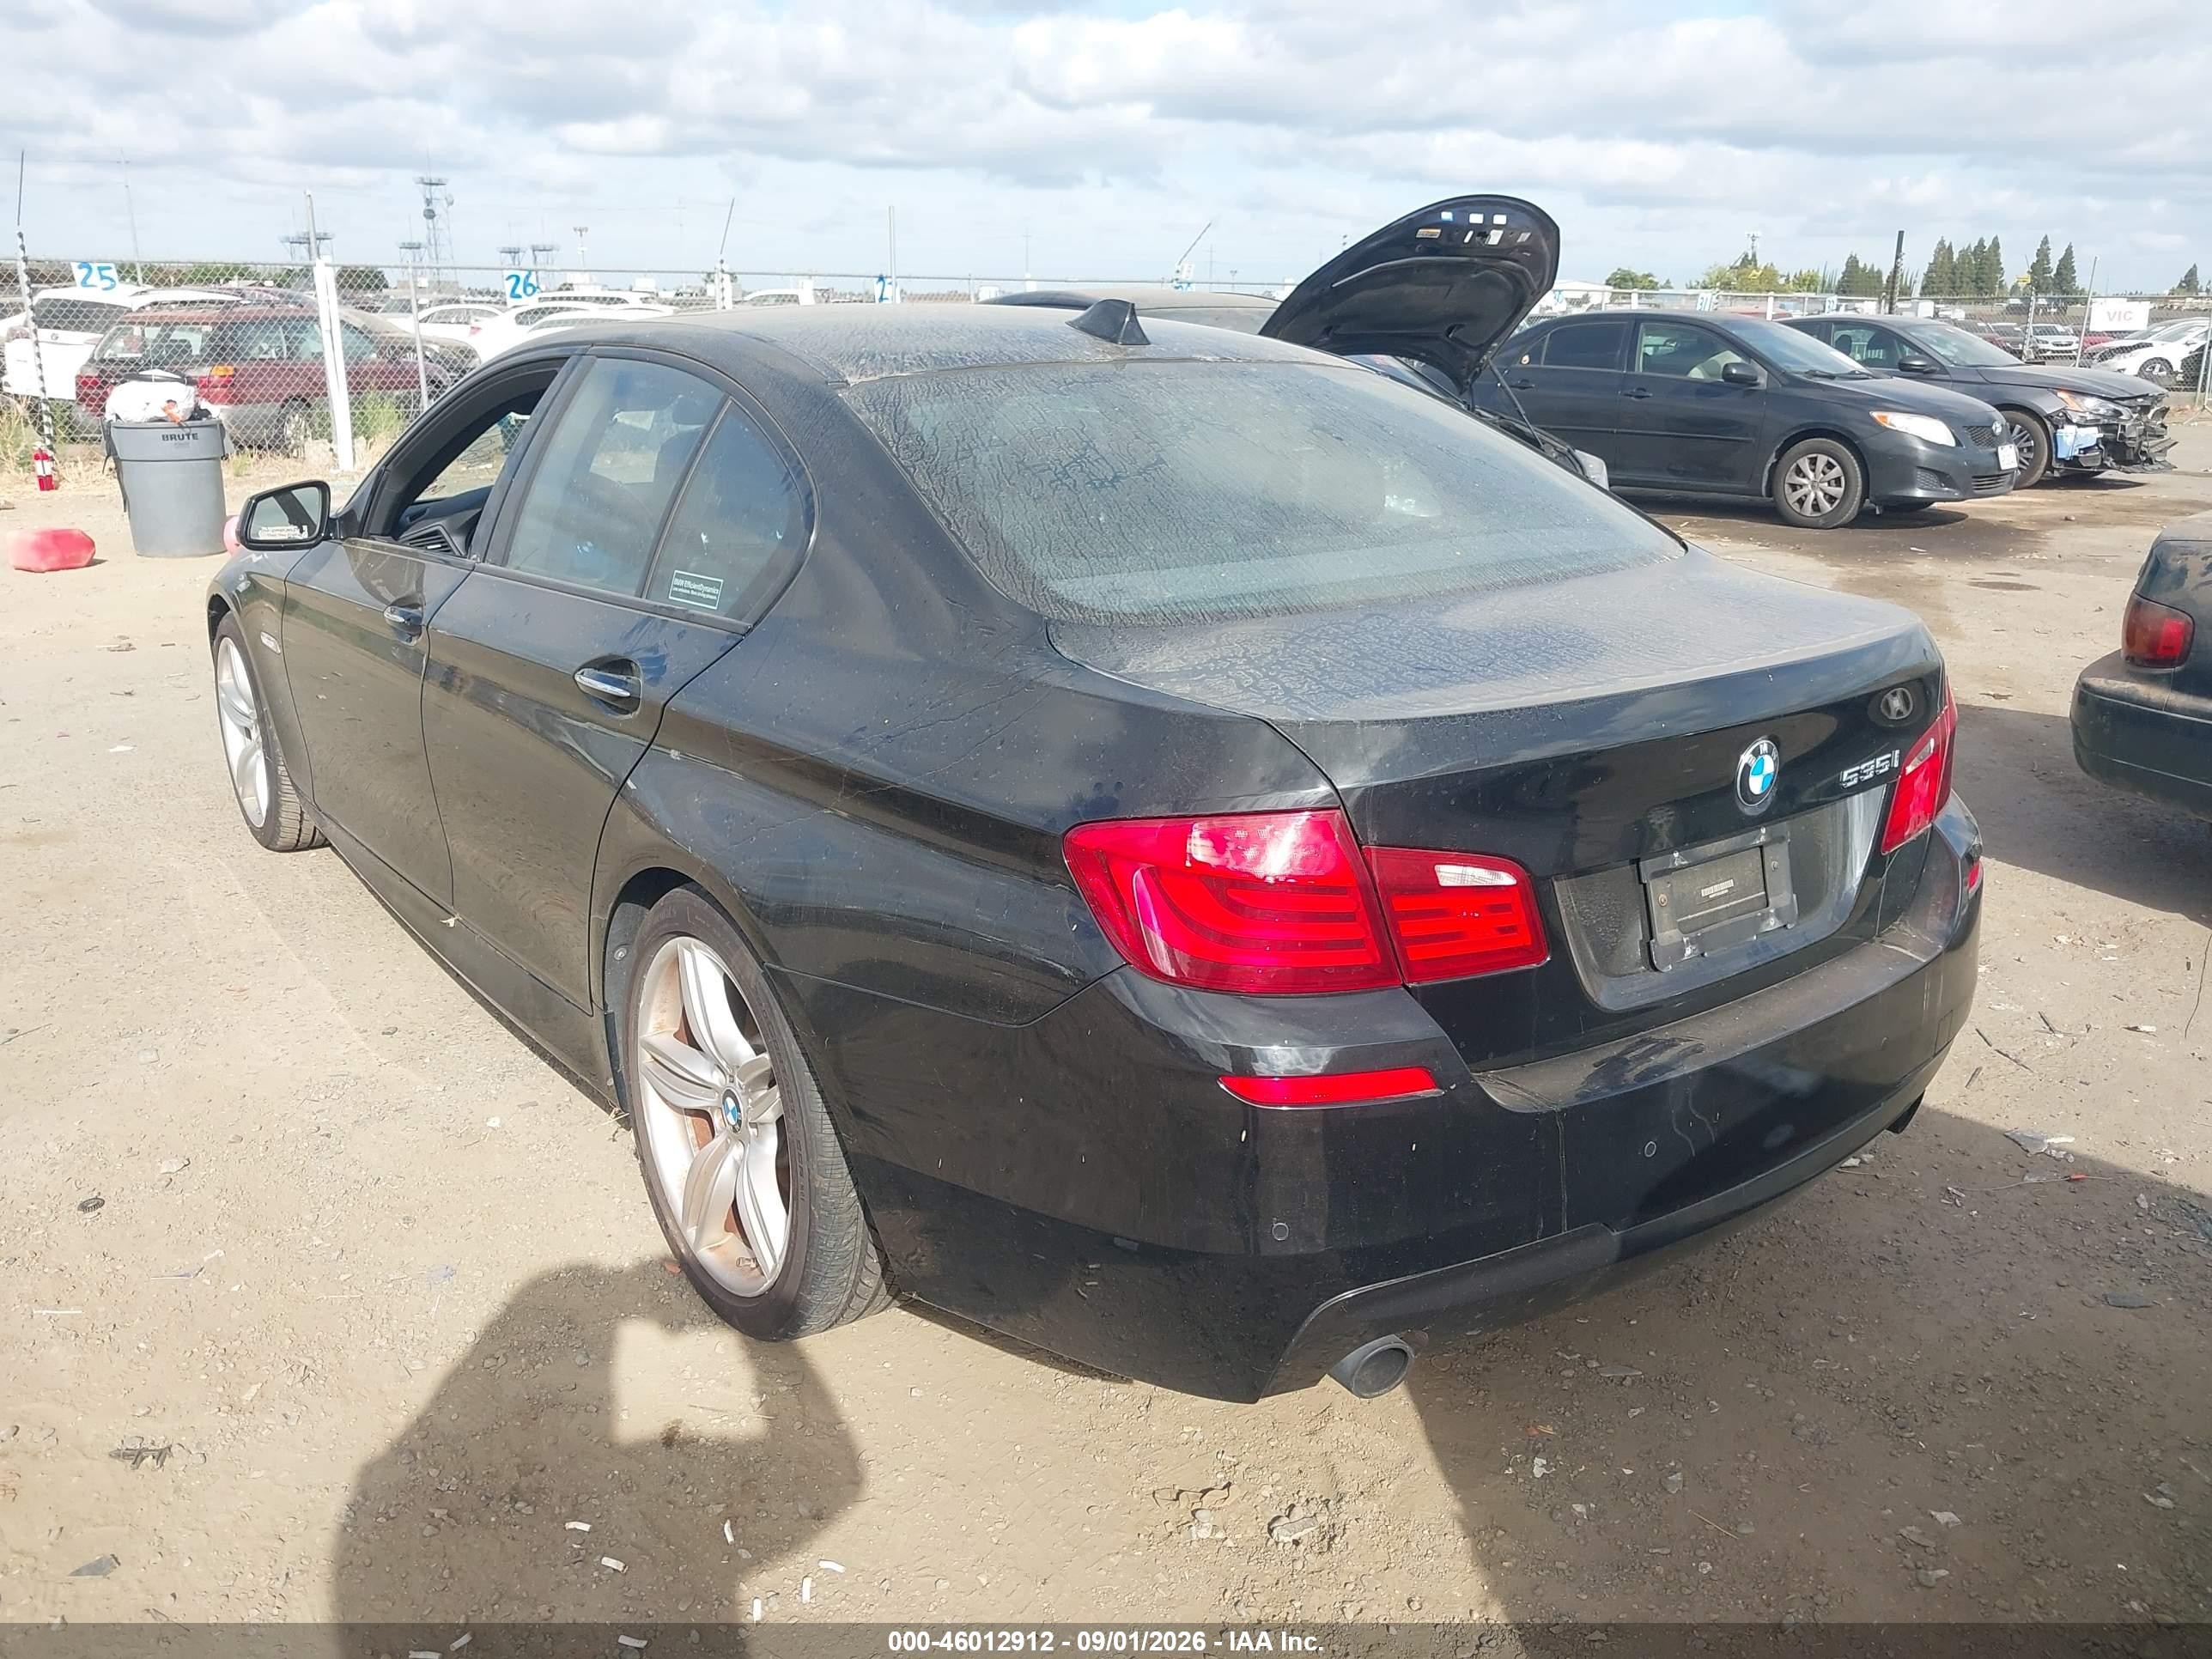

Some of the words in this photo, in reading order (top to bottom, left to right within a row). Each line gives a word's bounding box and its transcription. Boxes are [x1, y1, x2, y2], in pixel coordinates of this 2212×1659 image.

[77, 262, 117, 290] 25
[506, 269, 537, 299] 26
[2106, 311, 2133, 322] VIC
[161, 433, 198, 441] BRUTE
[1839, 749, 1900, 788] 535i
